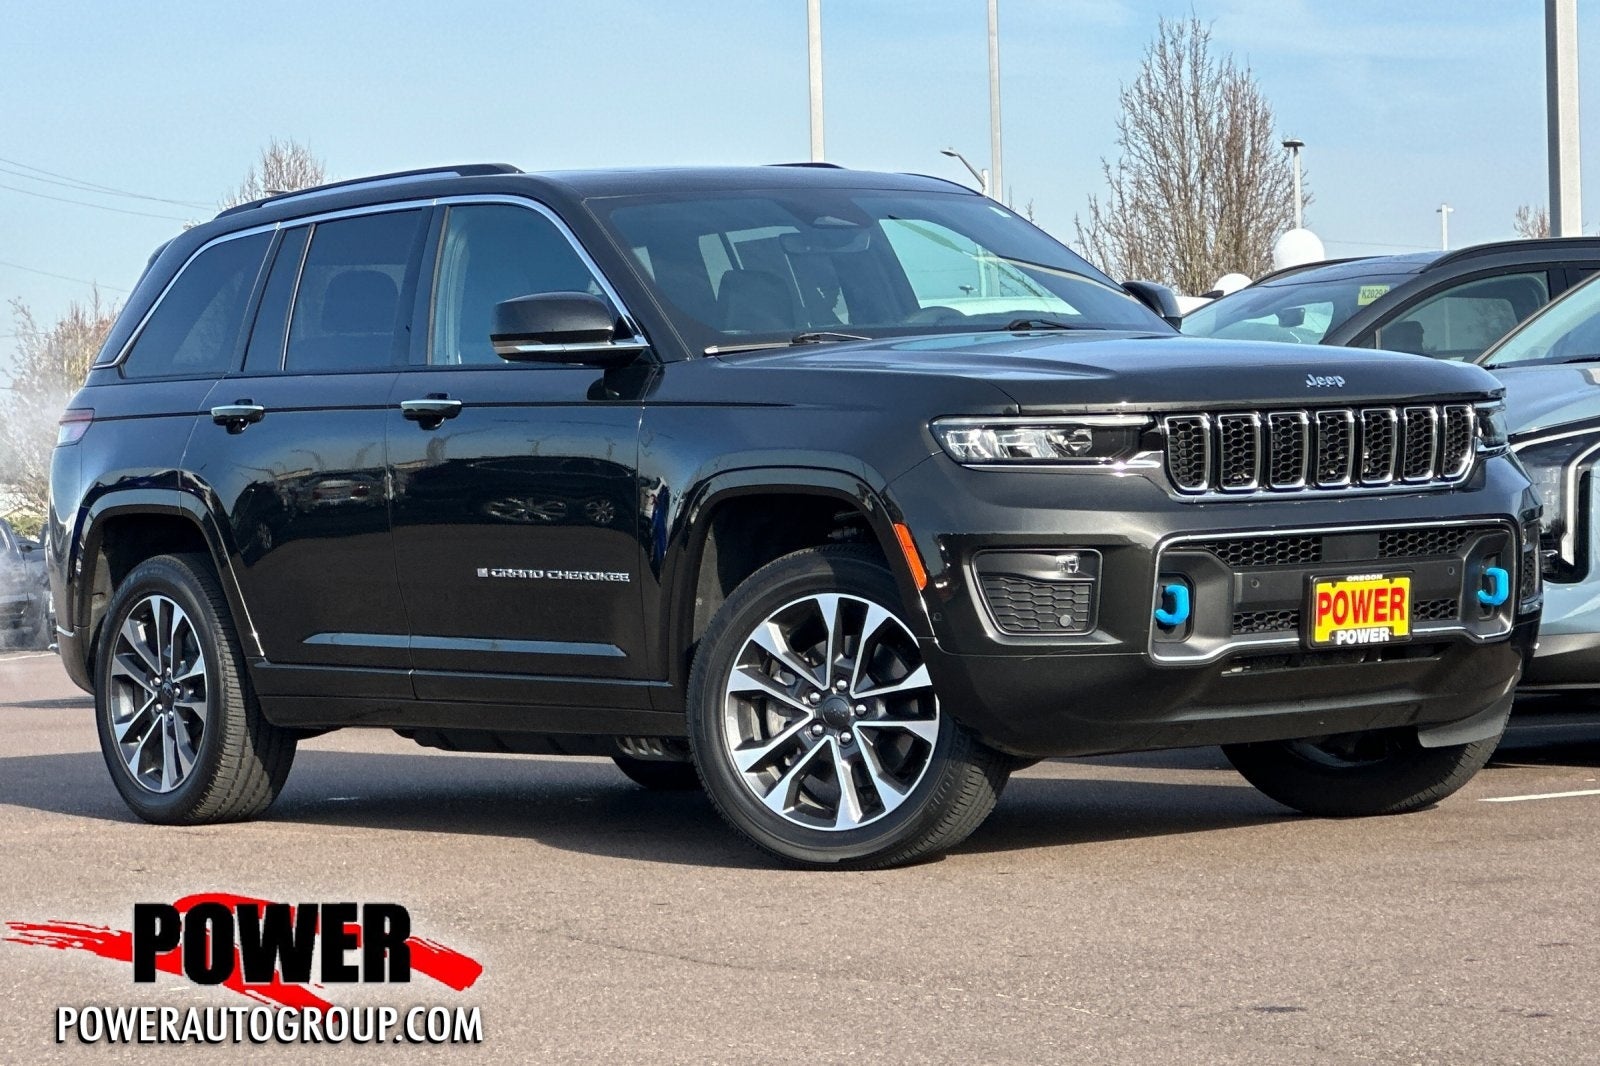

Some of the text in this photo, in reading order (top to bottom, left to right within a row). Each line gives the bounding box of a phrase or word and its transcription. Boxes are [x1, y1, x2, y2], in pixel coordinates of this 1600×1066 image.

[1305, 373, 1346, 388] Jeep
[490, 568, 631, 582] GRAND CHEROKEE
[1346, 573, 1384, 583] OREGON
[1317, 587, 1406, 627] POWER
[1336, 627, 1390, 646] POWER
